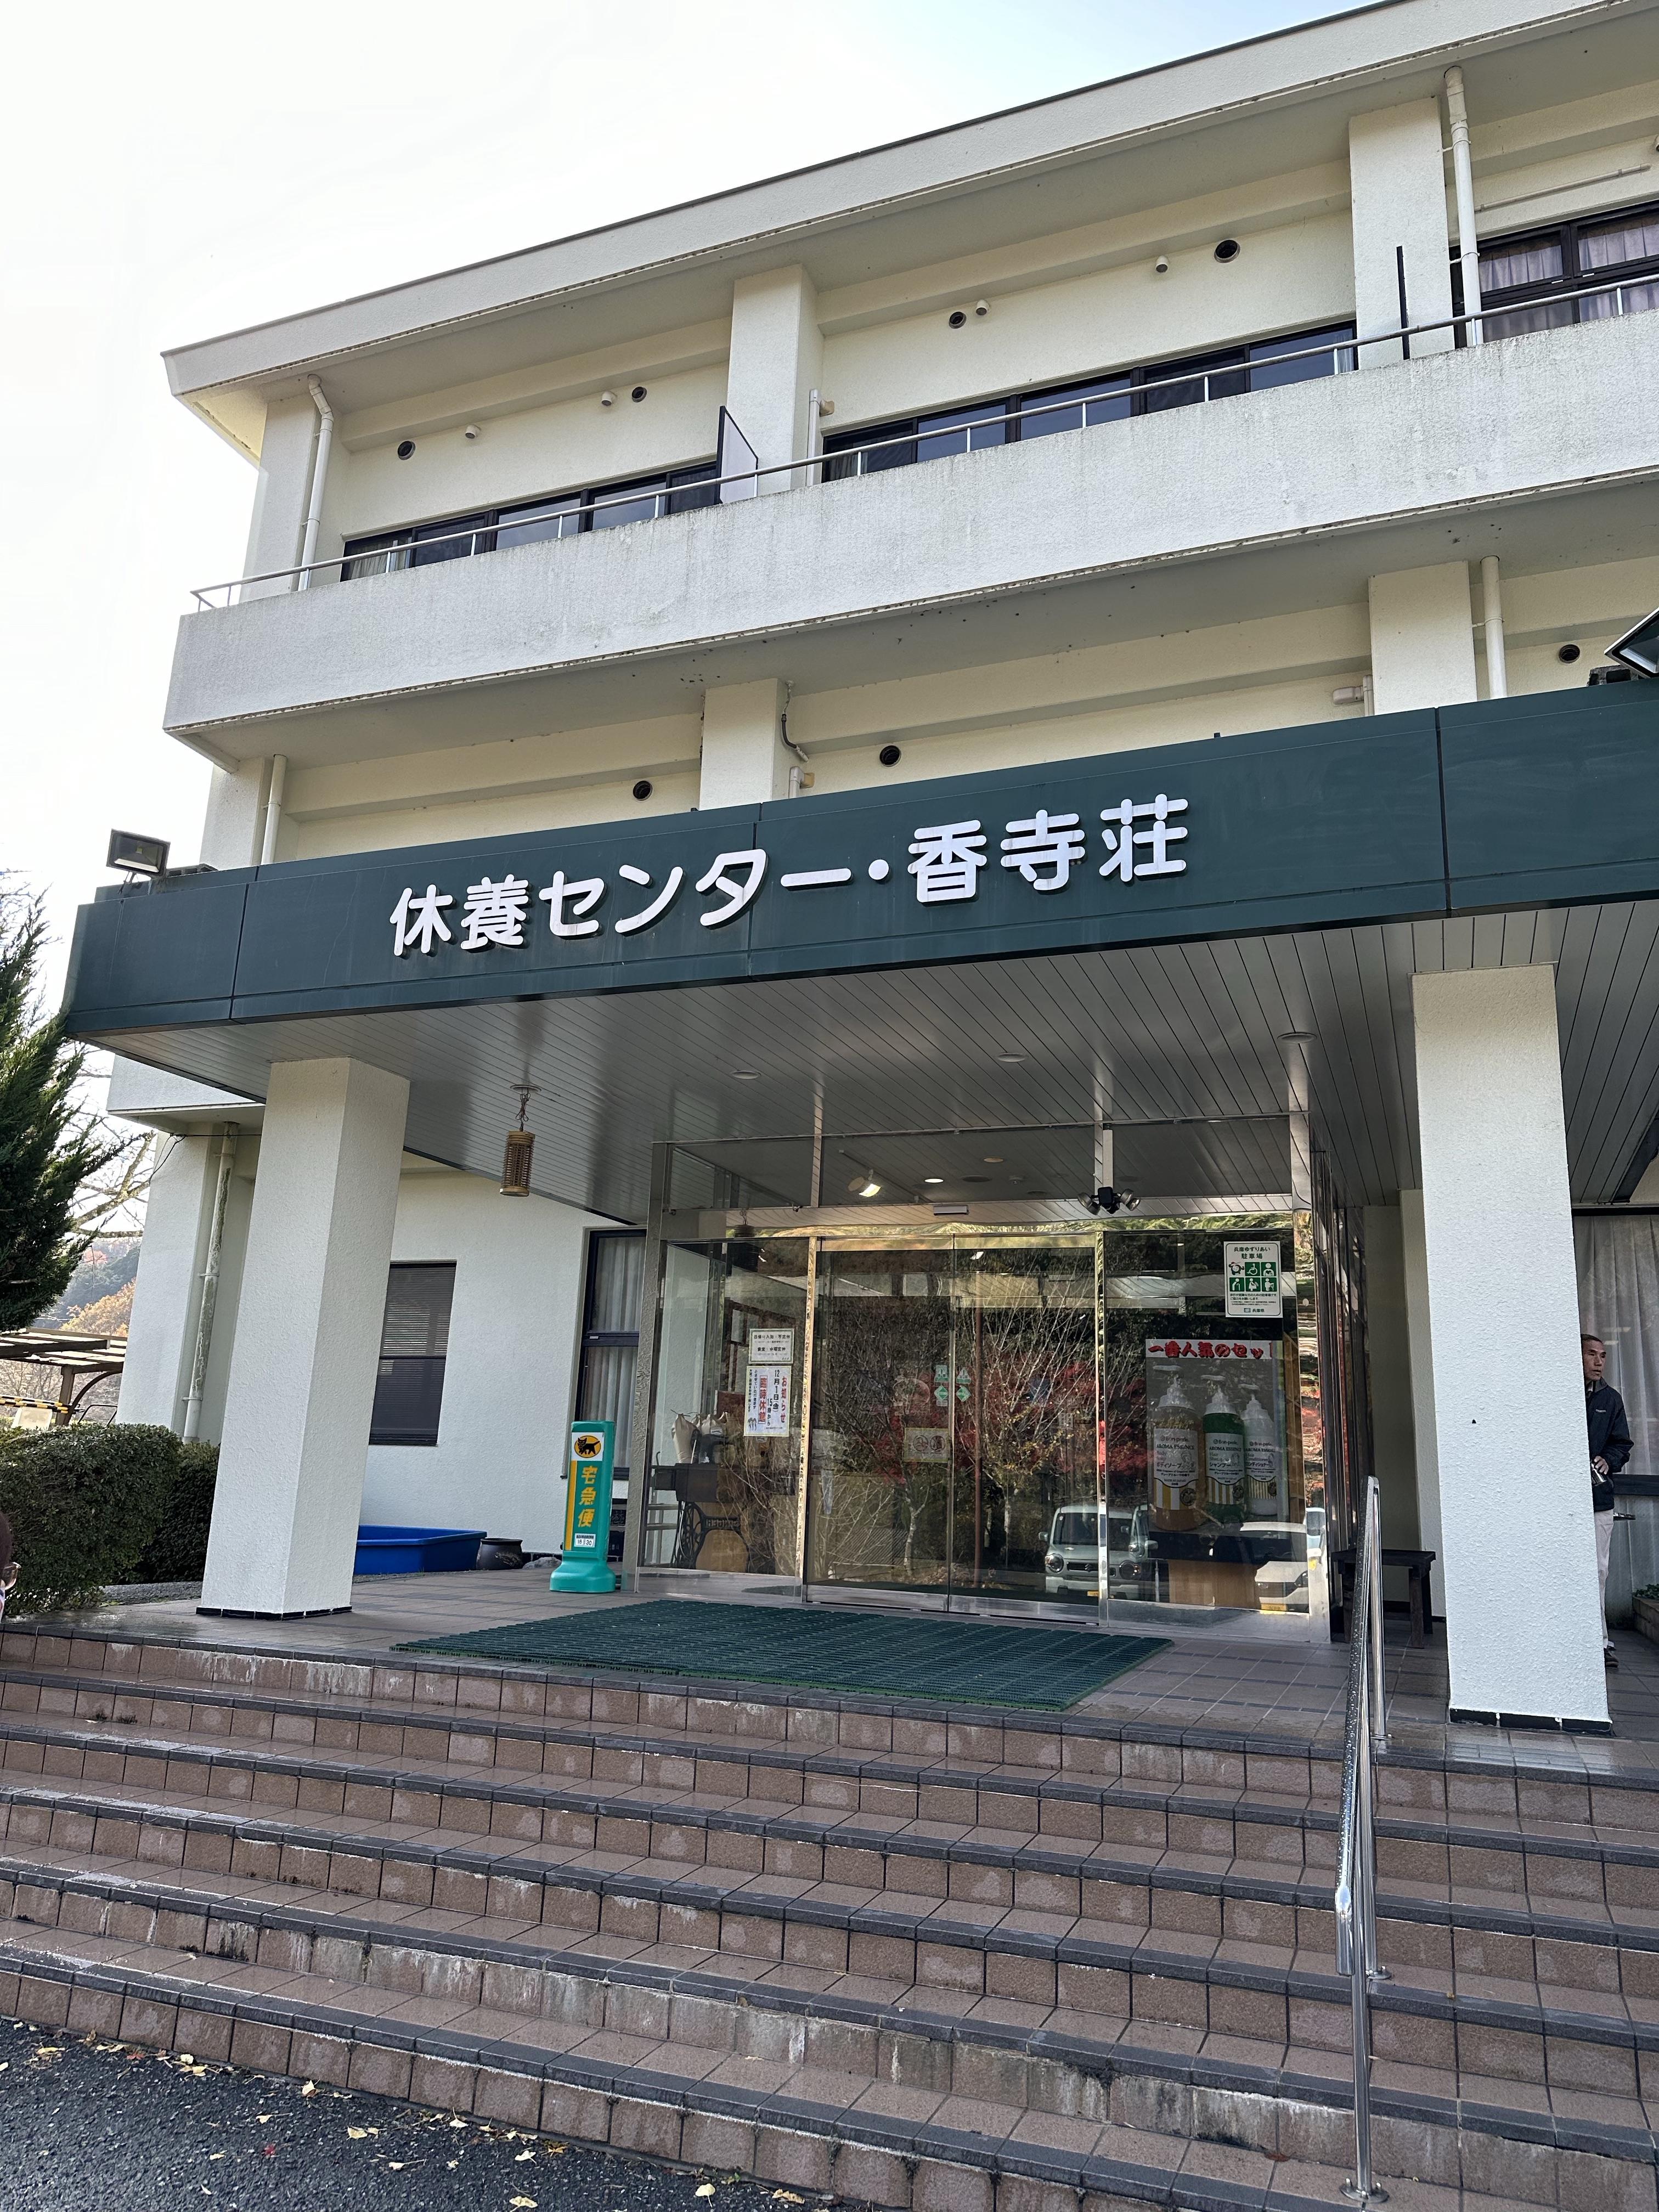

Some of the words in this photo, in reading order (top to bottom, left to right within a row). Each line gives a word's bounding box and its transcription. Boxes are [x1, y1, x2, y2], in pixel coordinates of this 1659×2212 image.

[389, 793, 1189, 957] 休養センター・香寺荘
[759, 1377, 767, 1422] 臨時休館
[578, 1465, 599, 1528] 宅急便
